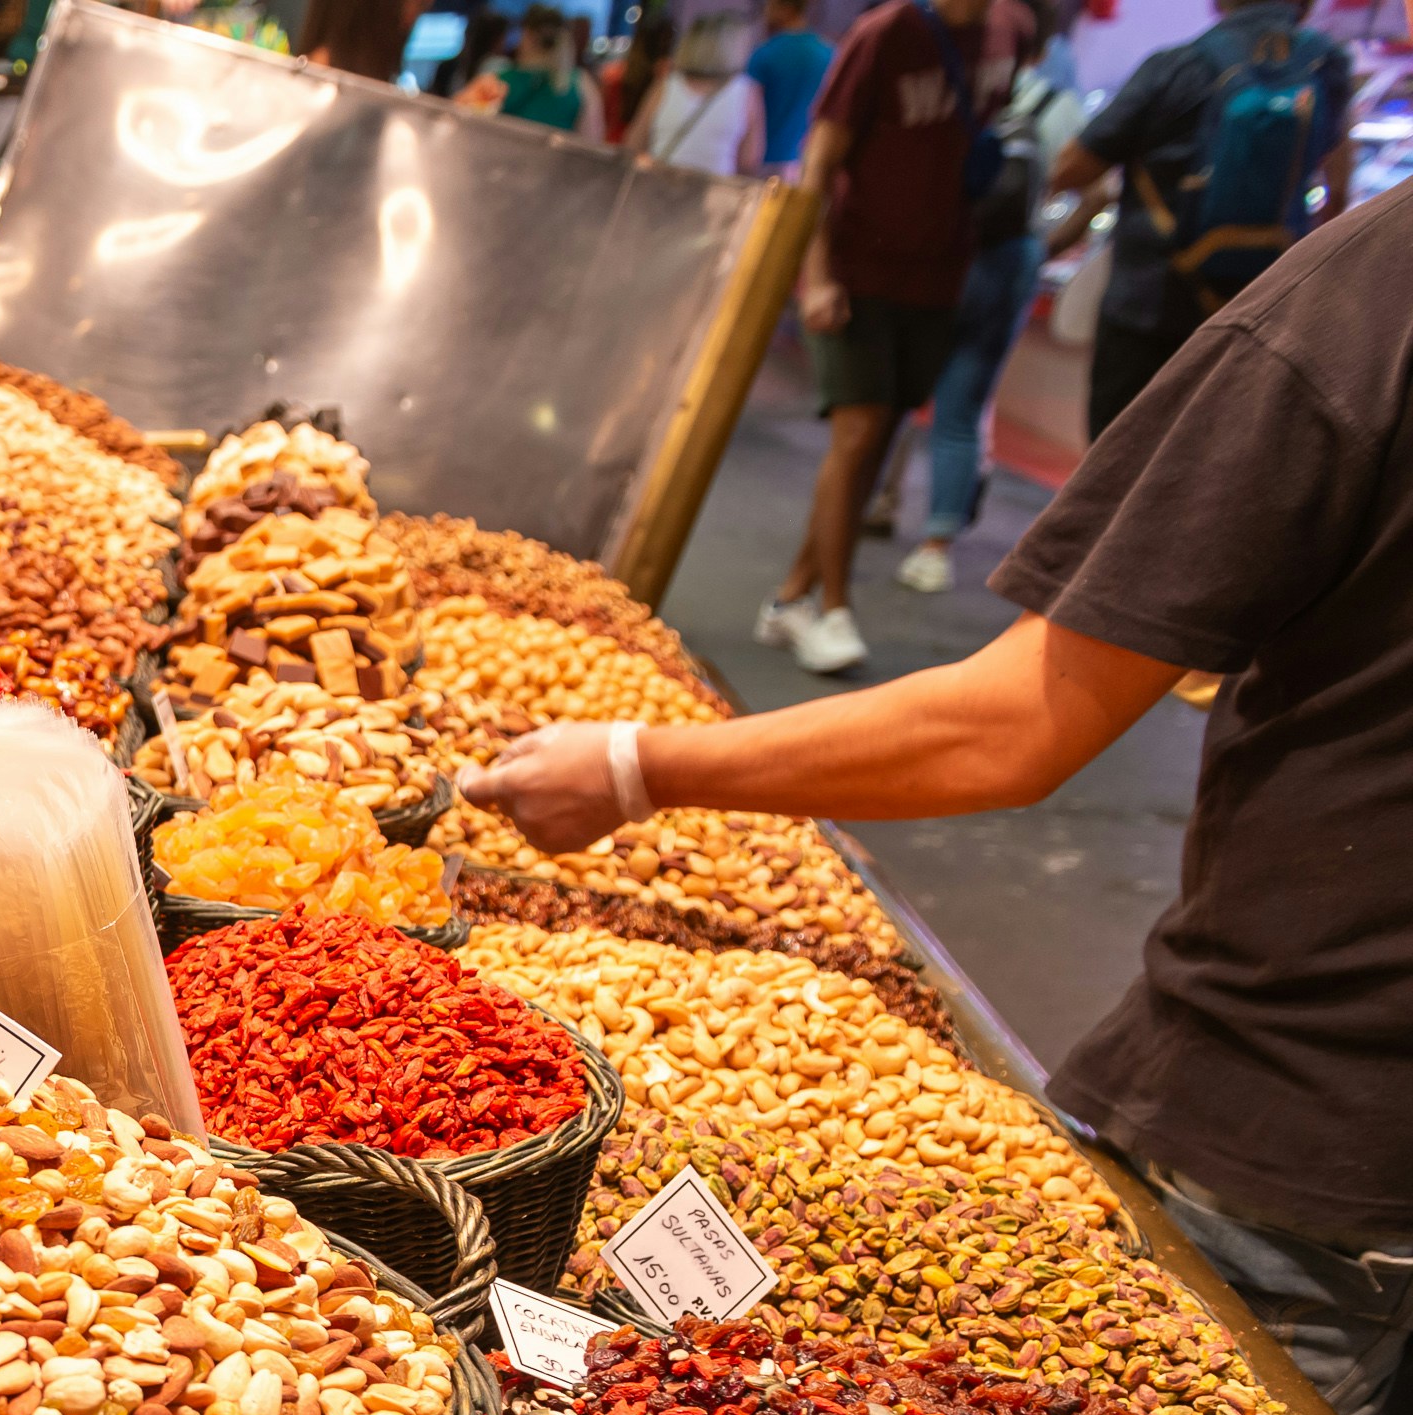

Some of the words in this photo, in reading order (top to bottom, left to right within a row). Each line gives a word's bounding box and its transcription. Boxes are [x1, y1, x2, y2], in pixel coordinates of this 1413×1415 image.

[660, 1213, 733, 1299] SULTANAS
[687, 1208, 736, 1261] PASAS
[519, 1321, 587, 1350] ENSALA
